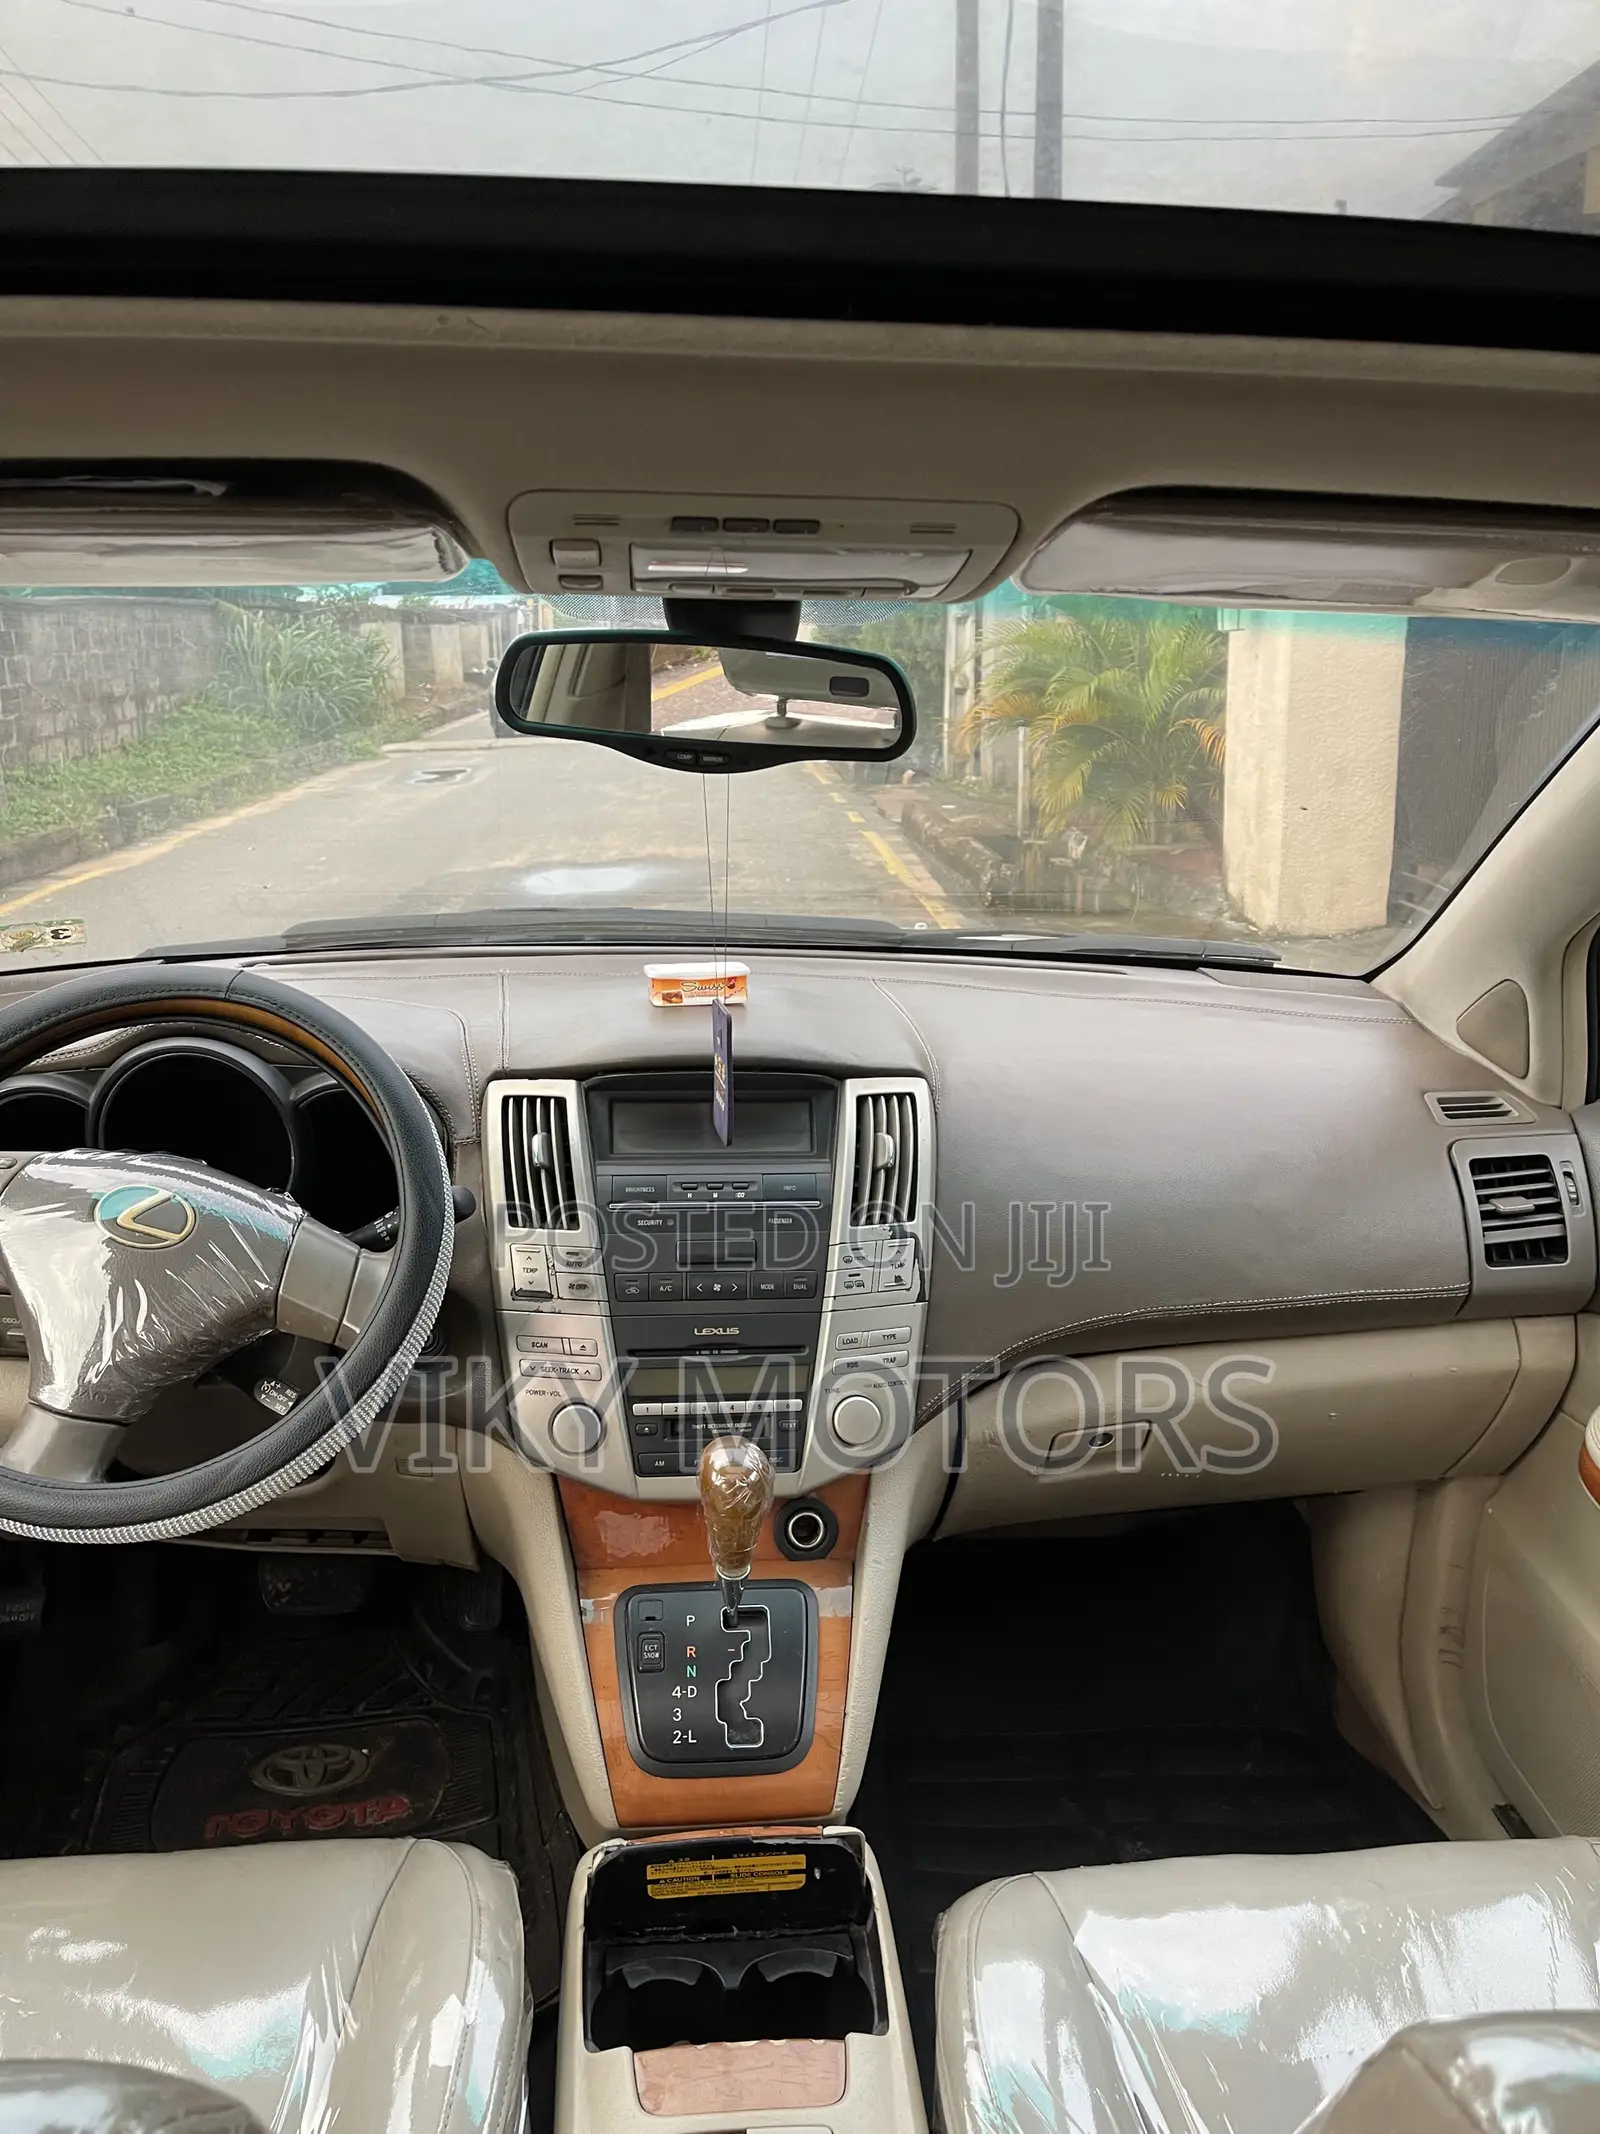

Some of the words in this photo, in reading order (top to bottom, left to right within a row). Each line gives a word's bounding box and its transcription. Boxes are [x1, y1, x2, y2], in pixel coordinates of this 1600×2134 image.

[681, 980, 725, 992] Swiss
[768, 1217, 793, 1225] PASSENGER
[760, 1283, 775, 1291] MODE
[694, 1327, 740, 1335] LEXUS
[842, 1337, 859, 1345] LOAD
[882, 1333, 897, 1341] TYPE
[531, 1341, 549, 1349] SCAN
[846, 1361, 859, 1369] RDS
[882, 1356, 897, 1364] TRAF
[285, 1388, 297, 1399] RES
[275, 1402, 286, 1412] SET
[686, 1615, 696, 1627] P
[686, 1646, 696, 1658] R
[686, 1666, 697, 1678] N
[671, 1686, 698, 1698] 4-D
[672, 1708, 682, 1722] 3
[672, 1730, 697, 1744] 2-L
[204, 1795, 411, 1838] TOYOTA
